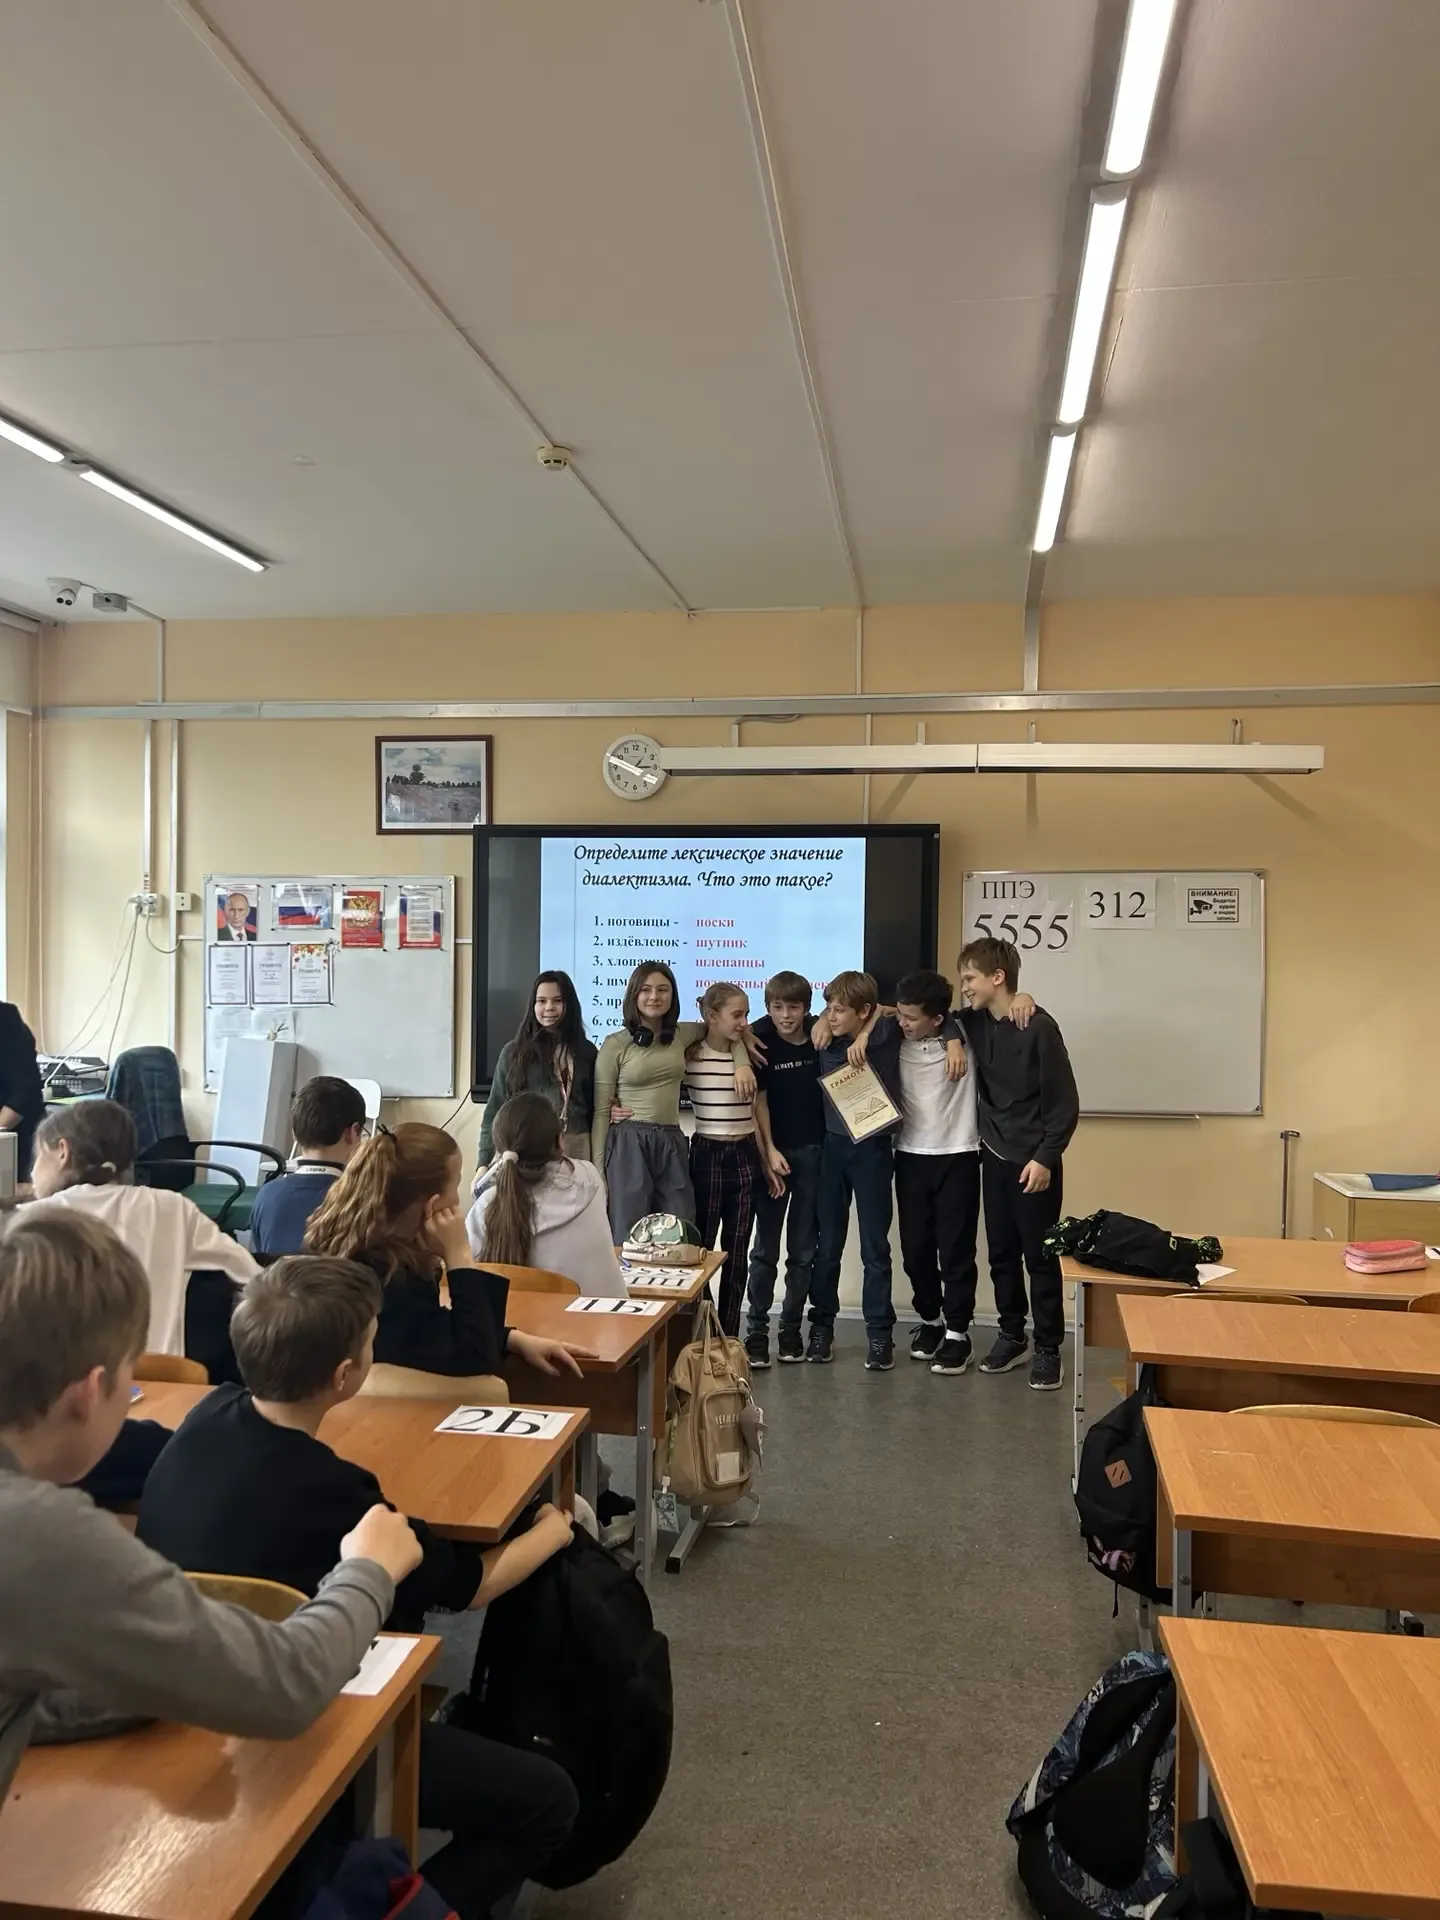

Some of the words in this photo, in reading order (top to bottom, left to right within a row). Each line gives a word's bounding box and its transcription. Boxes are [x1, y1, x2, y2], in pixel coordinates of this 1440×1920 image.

[574, 843, 668, 865] Определите
[671, 847, 766, 864] лексическое
[769, 848, 843, 860] значение
[582, 869, 691, 889] диалектизма.
[697, 872, 735, 887] Что
[739, 873, 770, 887] это
[775, 872, 833, 891] такое?
[982, 881, 1036, 899] ППЭ
[1089, 891, 1147, 918] 312
[594, 916, 604, 927] 1.
[607, 917, 670, 929] ноговицы
[696, 918, 735, 928] носки
[593, 936, 604, 947] 2.
[696, 938, 748, 950] шутник
[592, 955, 603, 967] 3.
[695, 958, 765, 969] шлепанцы
[592, 975, 603, 986] 4.
[592, 995, 603, 1006] 5.
[592, 1014, 603, 1026] 6.
[830, 1066, 866, 1089] ГРАМОТА
[440, 1408, 549, 1435] 2Б
